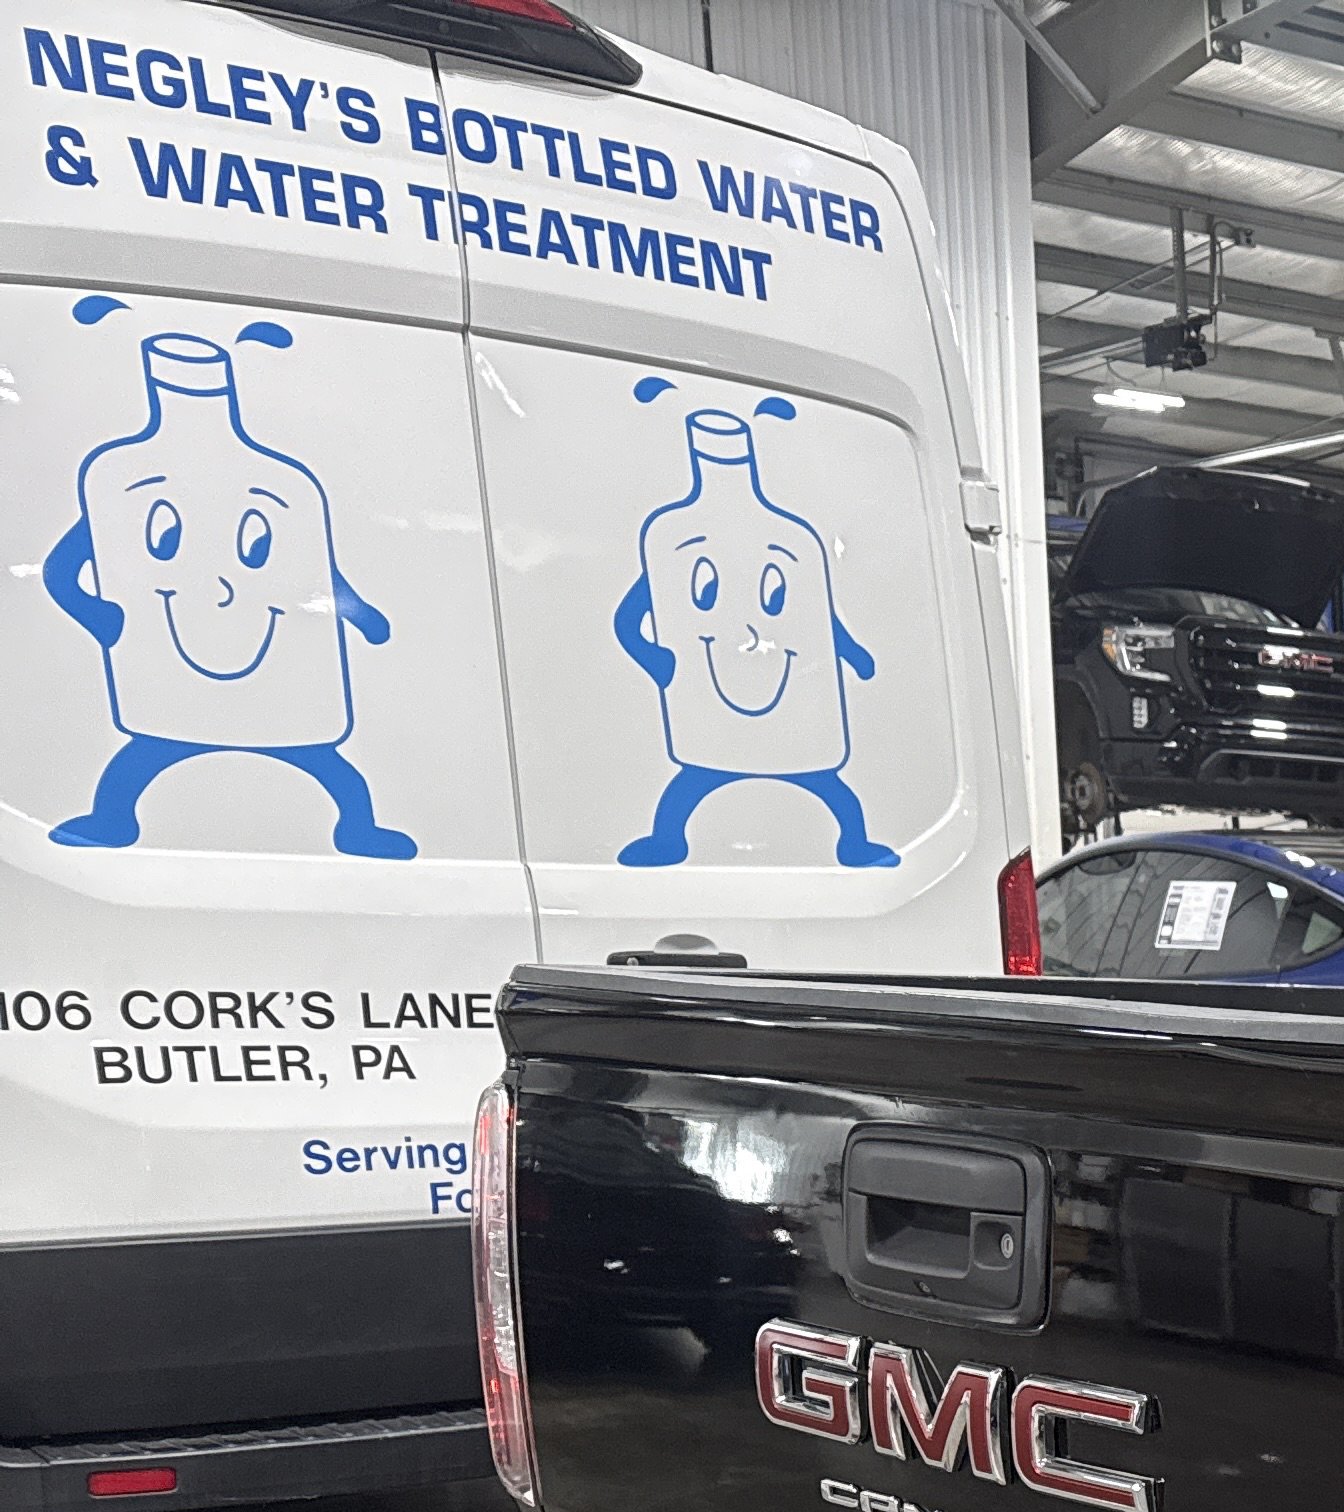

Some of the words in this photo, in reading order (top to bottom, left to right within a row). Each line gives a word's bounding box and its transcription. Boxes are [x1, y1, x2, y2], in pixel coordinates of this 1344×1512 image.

[25, 28, 382, 146] NEGLEY'S
[405, 97, 678, 202] BOTTLED
[698, 159, 884, 253] WATER
[45, 124, 98, 188] &
[128, 137, 388, 234] WATER
[407, 184, 773, 301] TREATMENT
[120, 990, 335, 1030] CORK'S
[360, 992, 495, 1029] LANE
[94, 1045, 328, 1089] BUTLER,
[351, 1044, 417, 1080] PA
[302, 1135, 468, 1175] Serving
